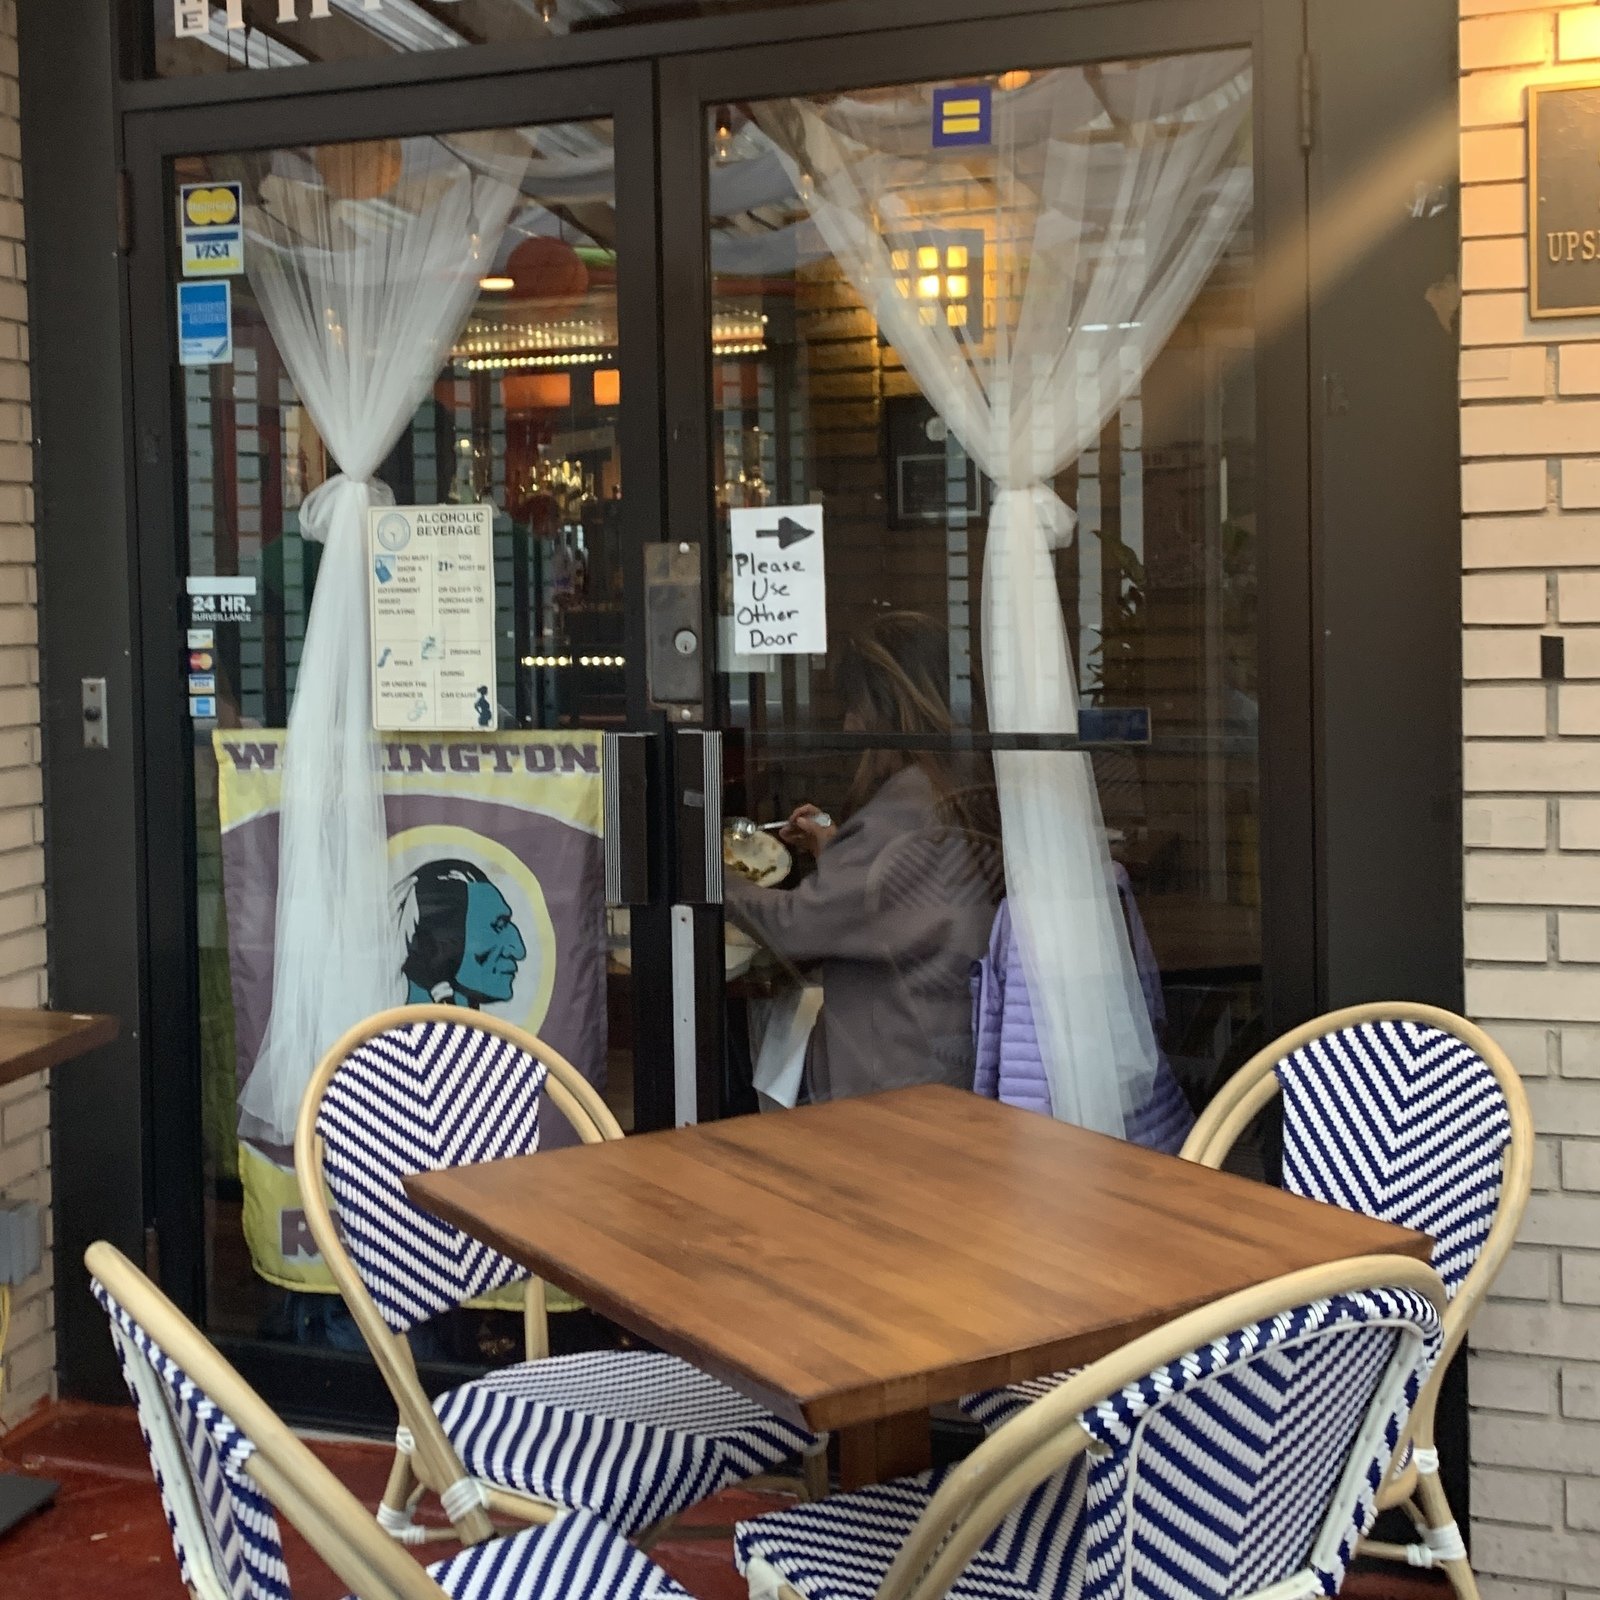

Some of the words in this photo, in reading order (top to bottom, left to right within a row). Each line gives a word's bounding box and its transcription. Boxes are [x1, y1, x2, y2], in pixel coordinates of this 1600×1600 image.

[195, 243, 229, 259] VISA
[1547, 230, 1600, 262] UPS
[416, 511, 484, 524] ALCOHOLIC
[416, 525, 481, 537] BEVERAGE
[438, 560, 454, 572] 21+
[735, 552, 805, 576] Please
[752, 578, 790, 601] Use
[192, 595, 216, 613] 24
[220, 595, 252, 613] HR.
[191, 612, 252, 622] SURVEILLANCE
[737, 603, 799, 625] Other
[750, 629, 798, 648] Door
